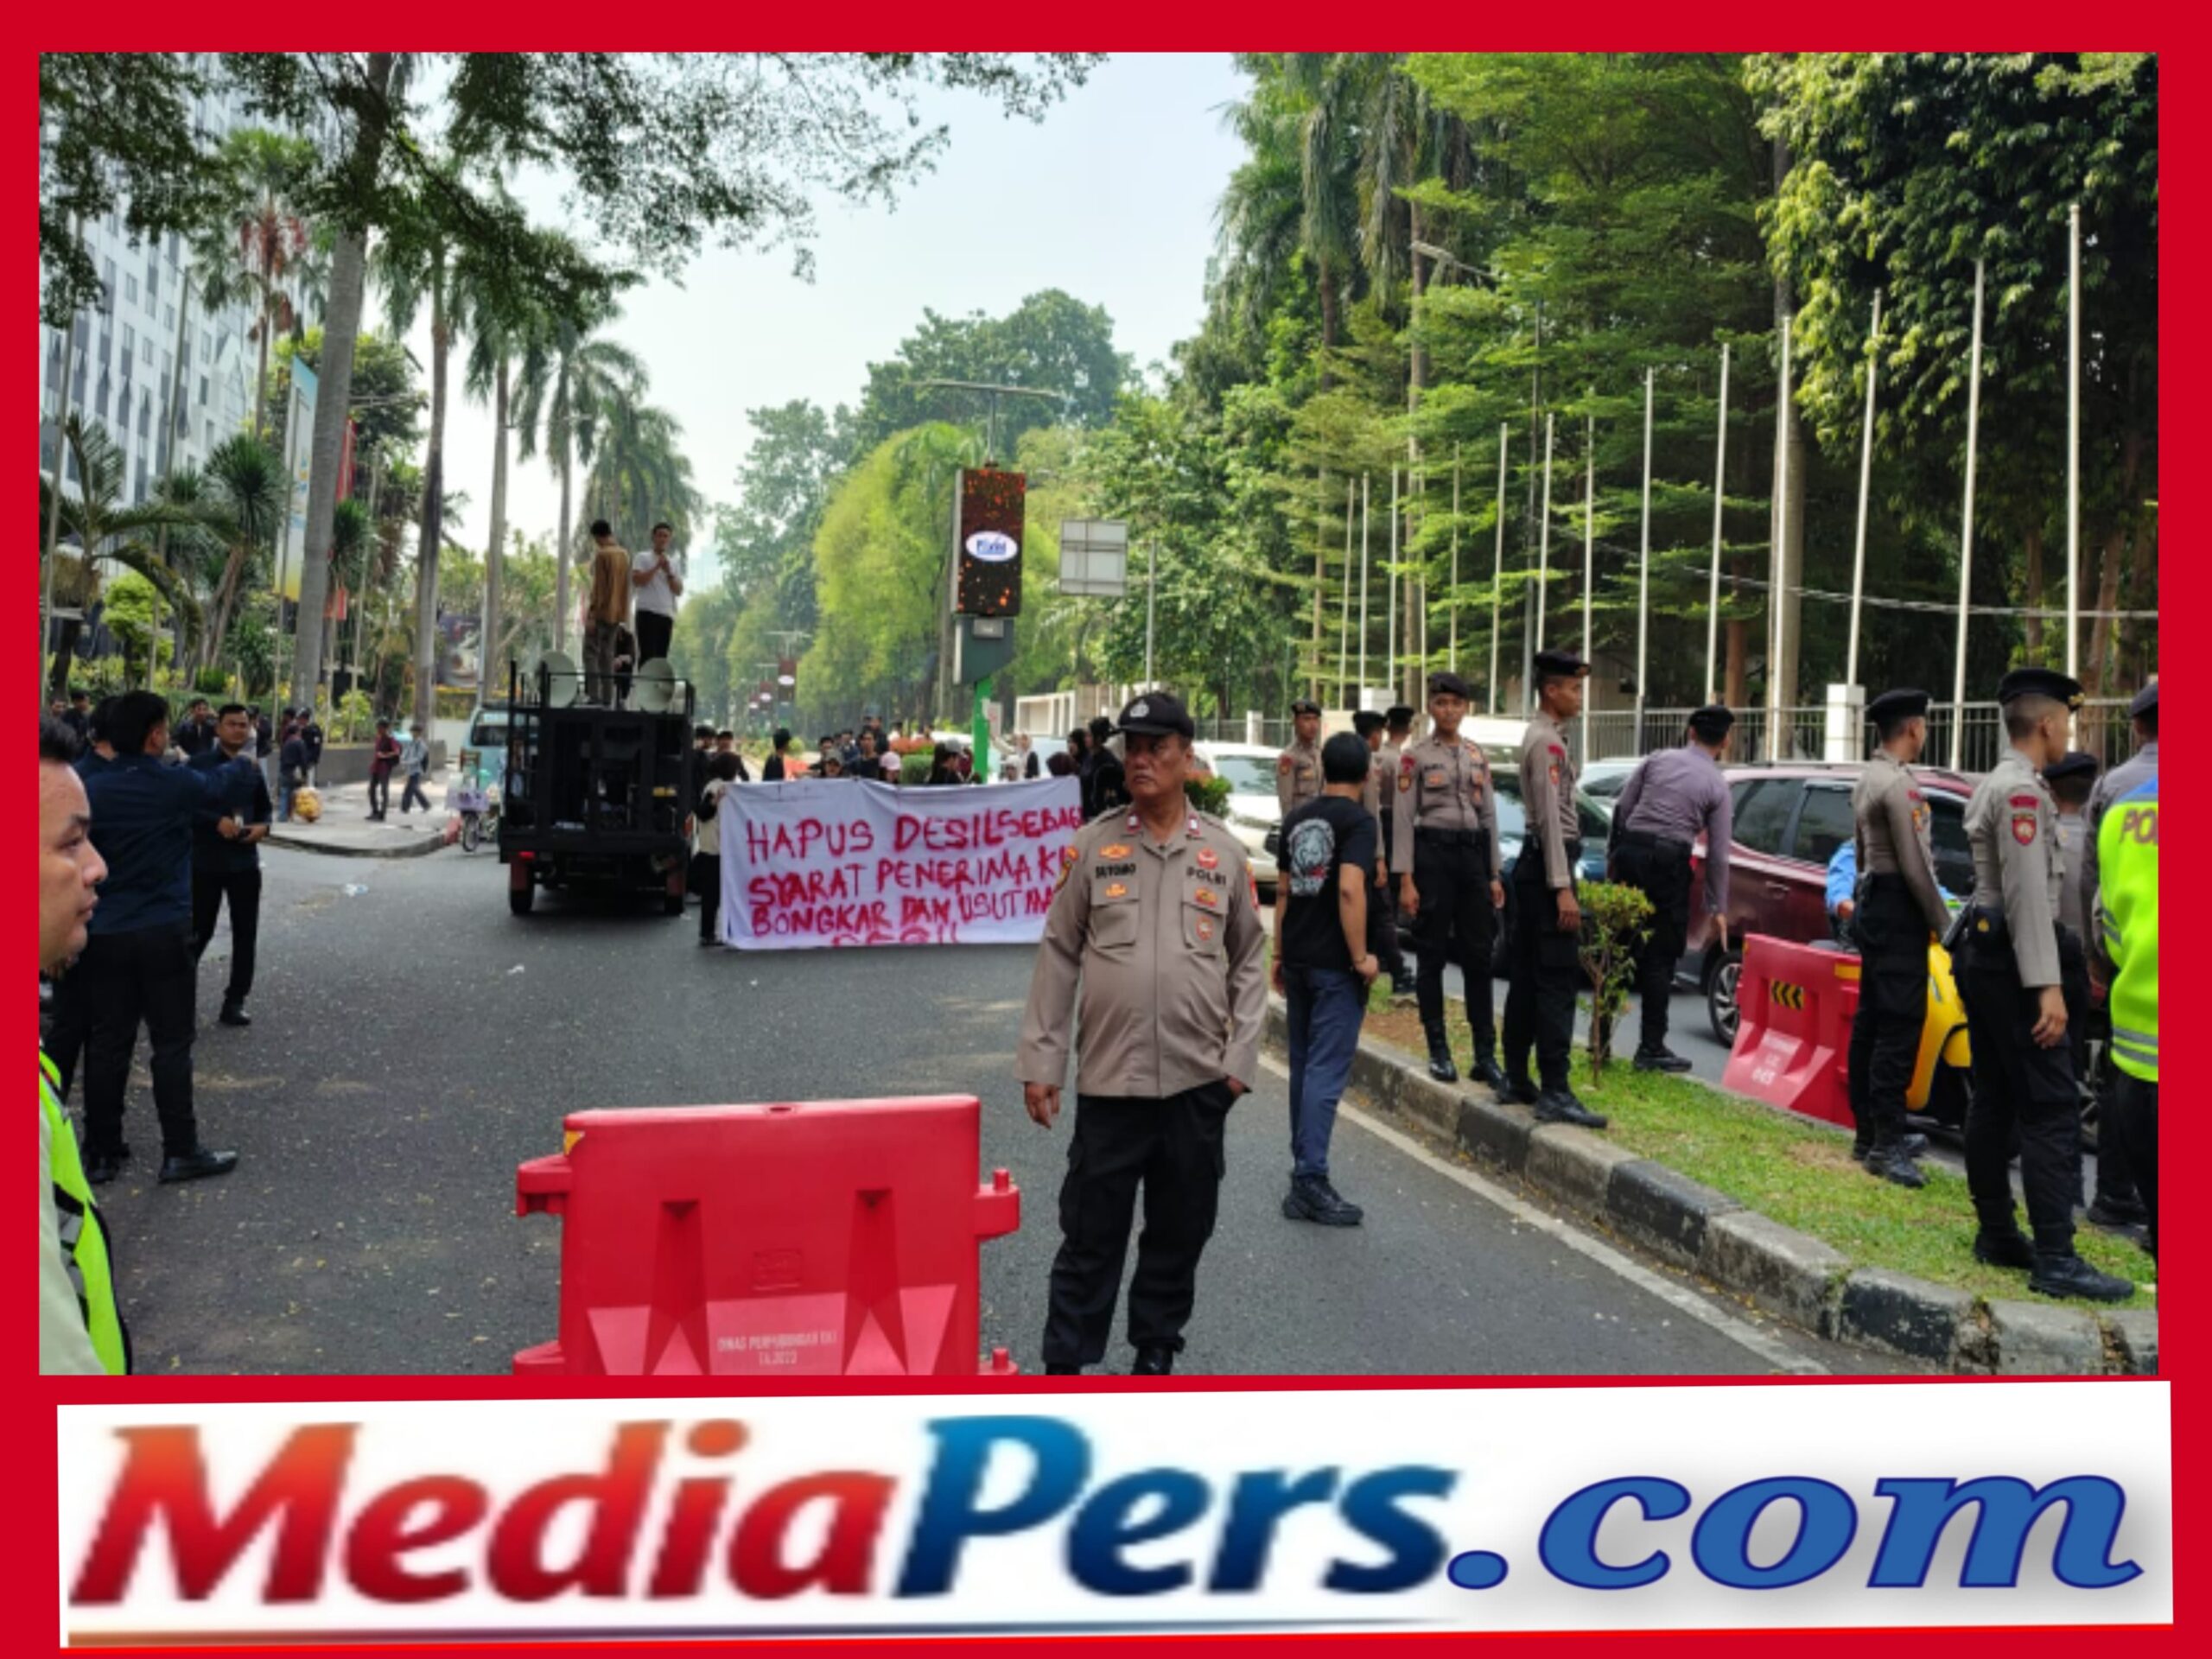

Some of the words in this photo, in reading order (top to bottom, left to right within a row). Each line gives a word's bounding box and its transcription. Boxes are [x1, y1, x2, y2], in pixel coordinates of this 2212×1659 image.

[747, 817, 874, 865] HAPUS
[893, 809, 1003, 852] DESIL
[2120, 808, 2158, 846] PO
[748, 863, 867, 907] SYARAT
[876, 848, 1032, 894] PENERIMA
[1186, 867, 1226, 886] POLRI
[752, 900, 893, 938] BONGKAR
[900, 895, 951, 926] DAN
[957, 889, 1022, 924] USUT
